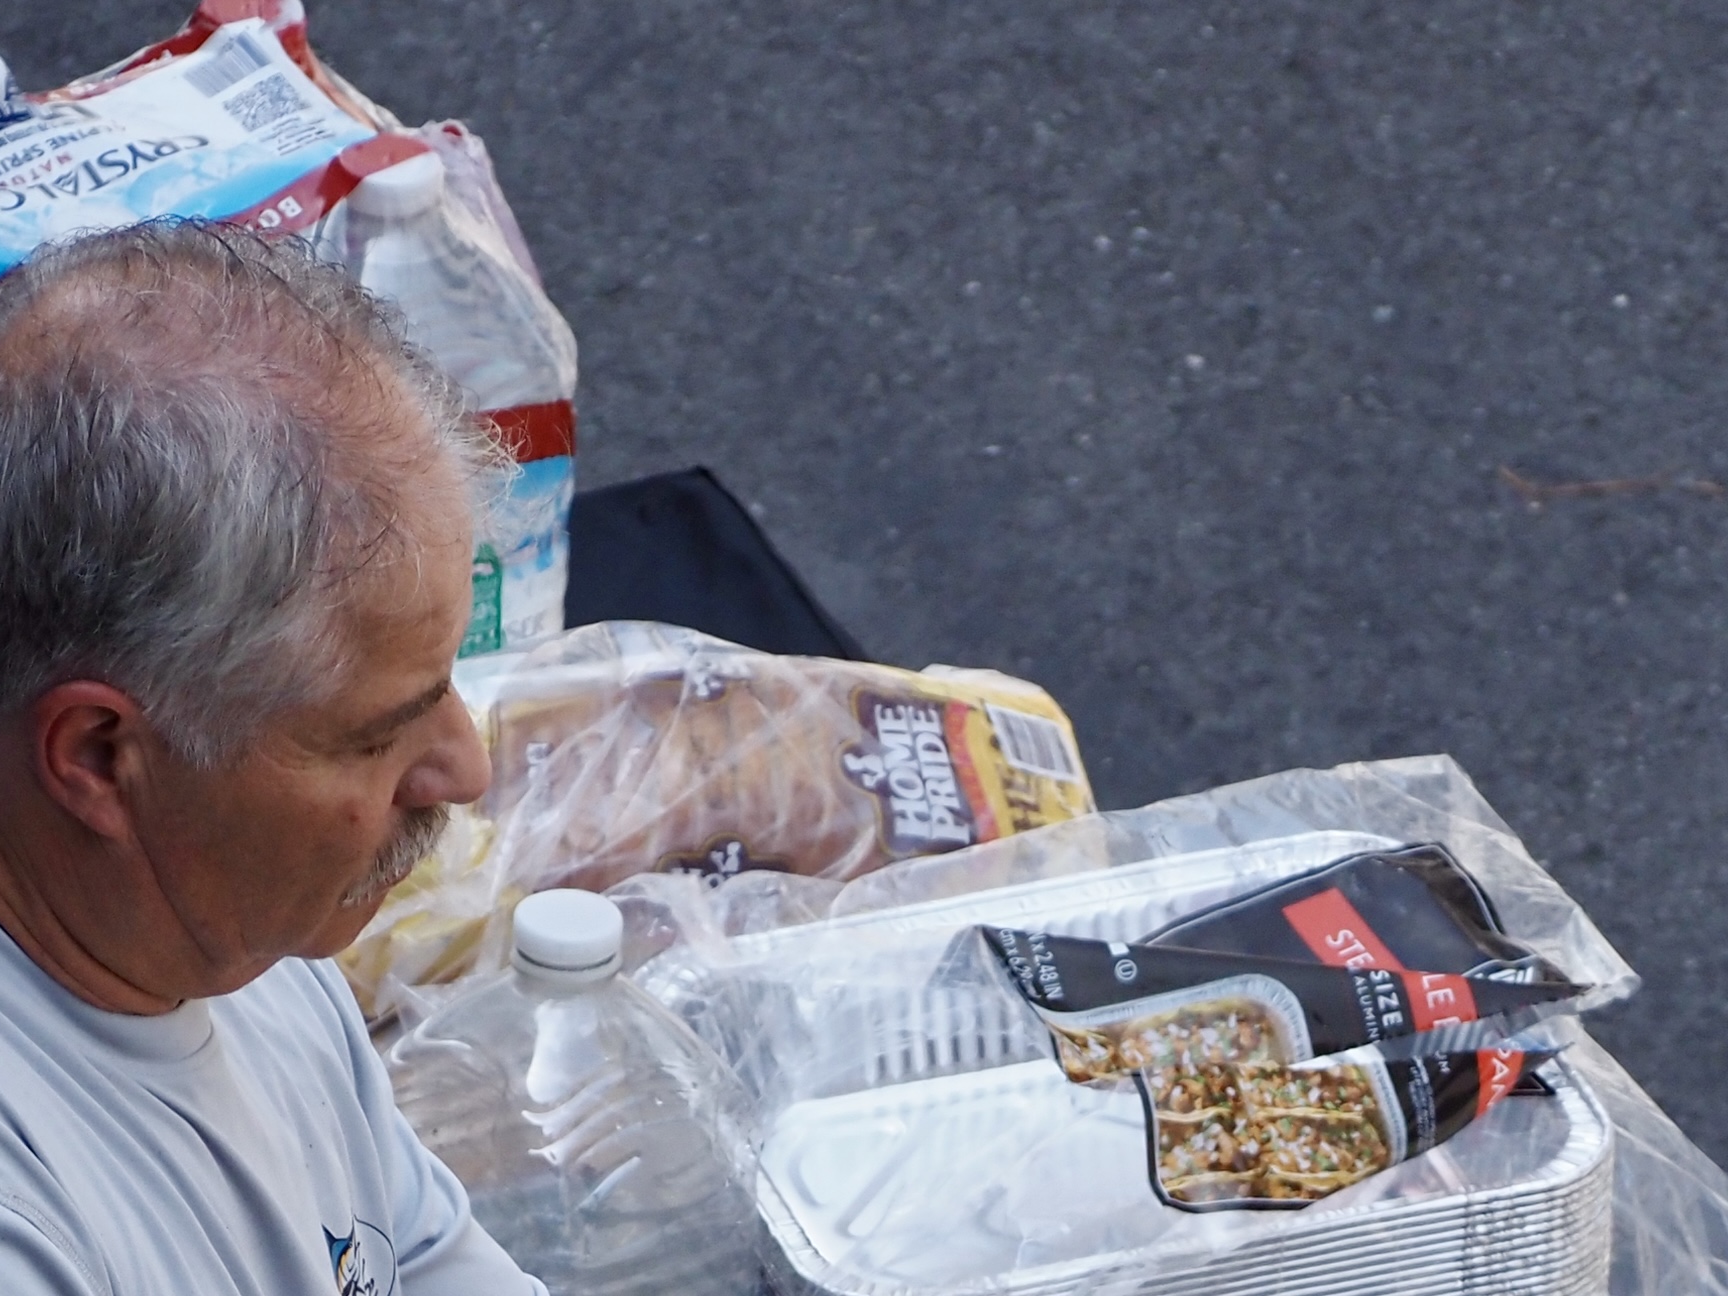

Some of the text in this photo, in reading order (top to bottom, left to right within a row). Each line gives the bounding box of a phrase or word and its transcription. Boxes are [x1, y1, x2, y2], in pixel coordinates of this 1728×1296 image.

[30, 135, 209, 199] CRYSTAL
[875, 703, 931, 838] HOME
[909, 703, 971, 845] PRIDE
[1034, 951, 1059, 981] 2.48
[1371, 970, 1404, 1027] SIZE
[1354, 976, 1381, 1044] ALUMIN
